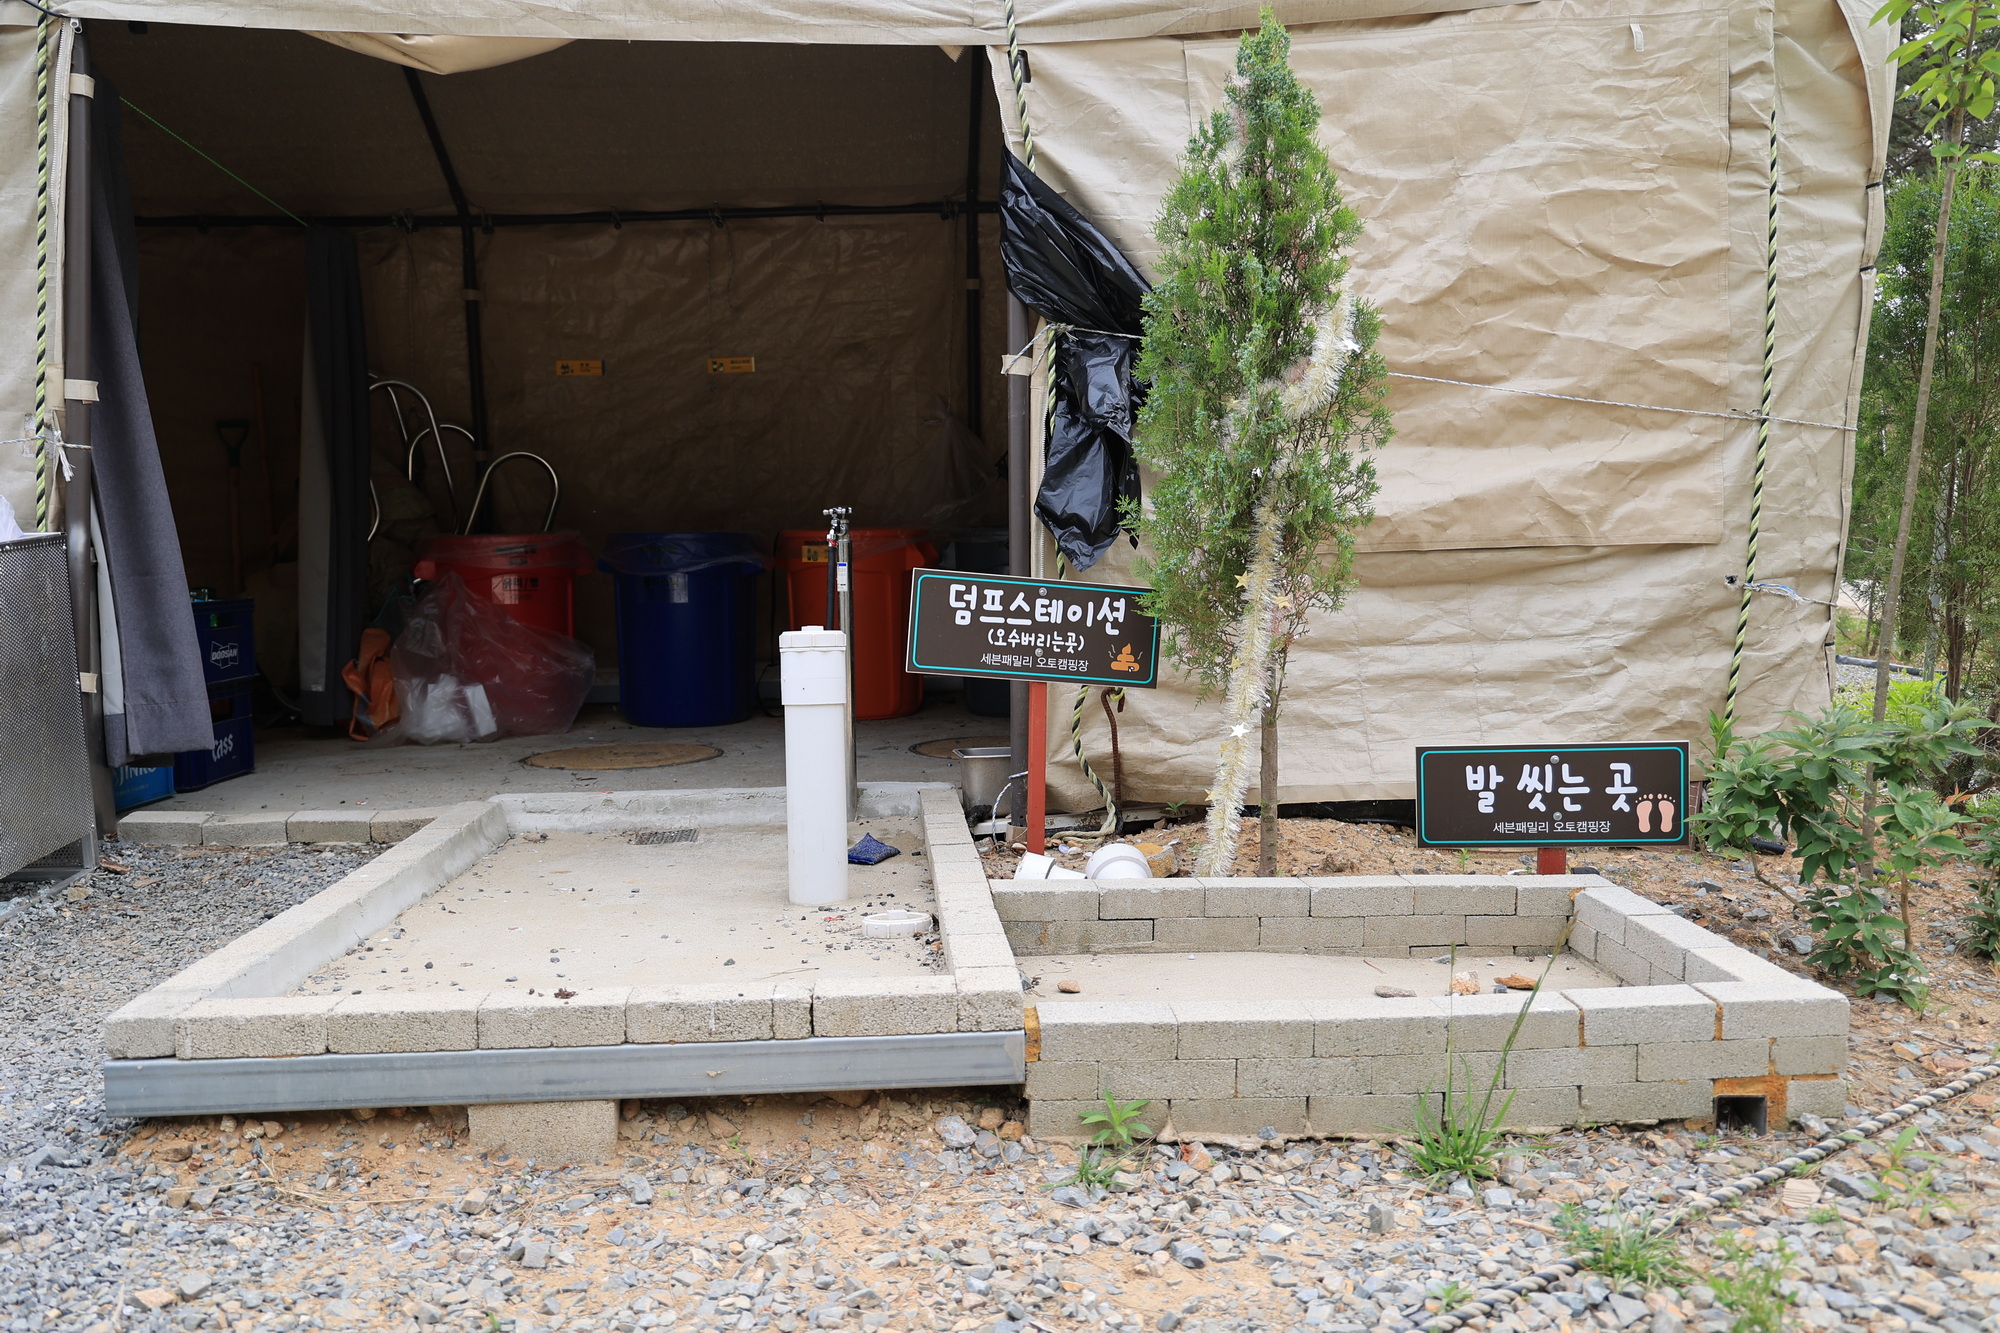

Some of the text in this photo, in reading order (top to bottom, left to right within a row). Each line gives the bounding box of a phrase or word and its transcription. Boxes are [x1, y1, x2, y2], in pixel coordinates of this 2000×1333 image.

[949, 583, 1126, 636] 덤프스테이션
[987, 628, 1085, 654] (오수버리는곳)
[211, 648, 238, 661] DOOSAN
[980, 652, 1089, 672] 세븐패밀리 오토캠핑장
[1465, 762, 1638, 814] 발 씻는 곳
[1492, 820, 1611, 834] 세븐패밀리 오토캠핑장
